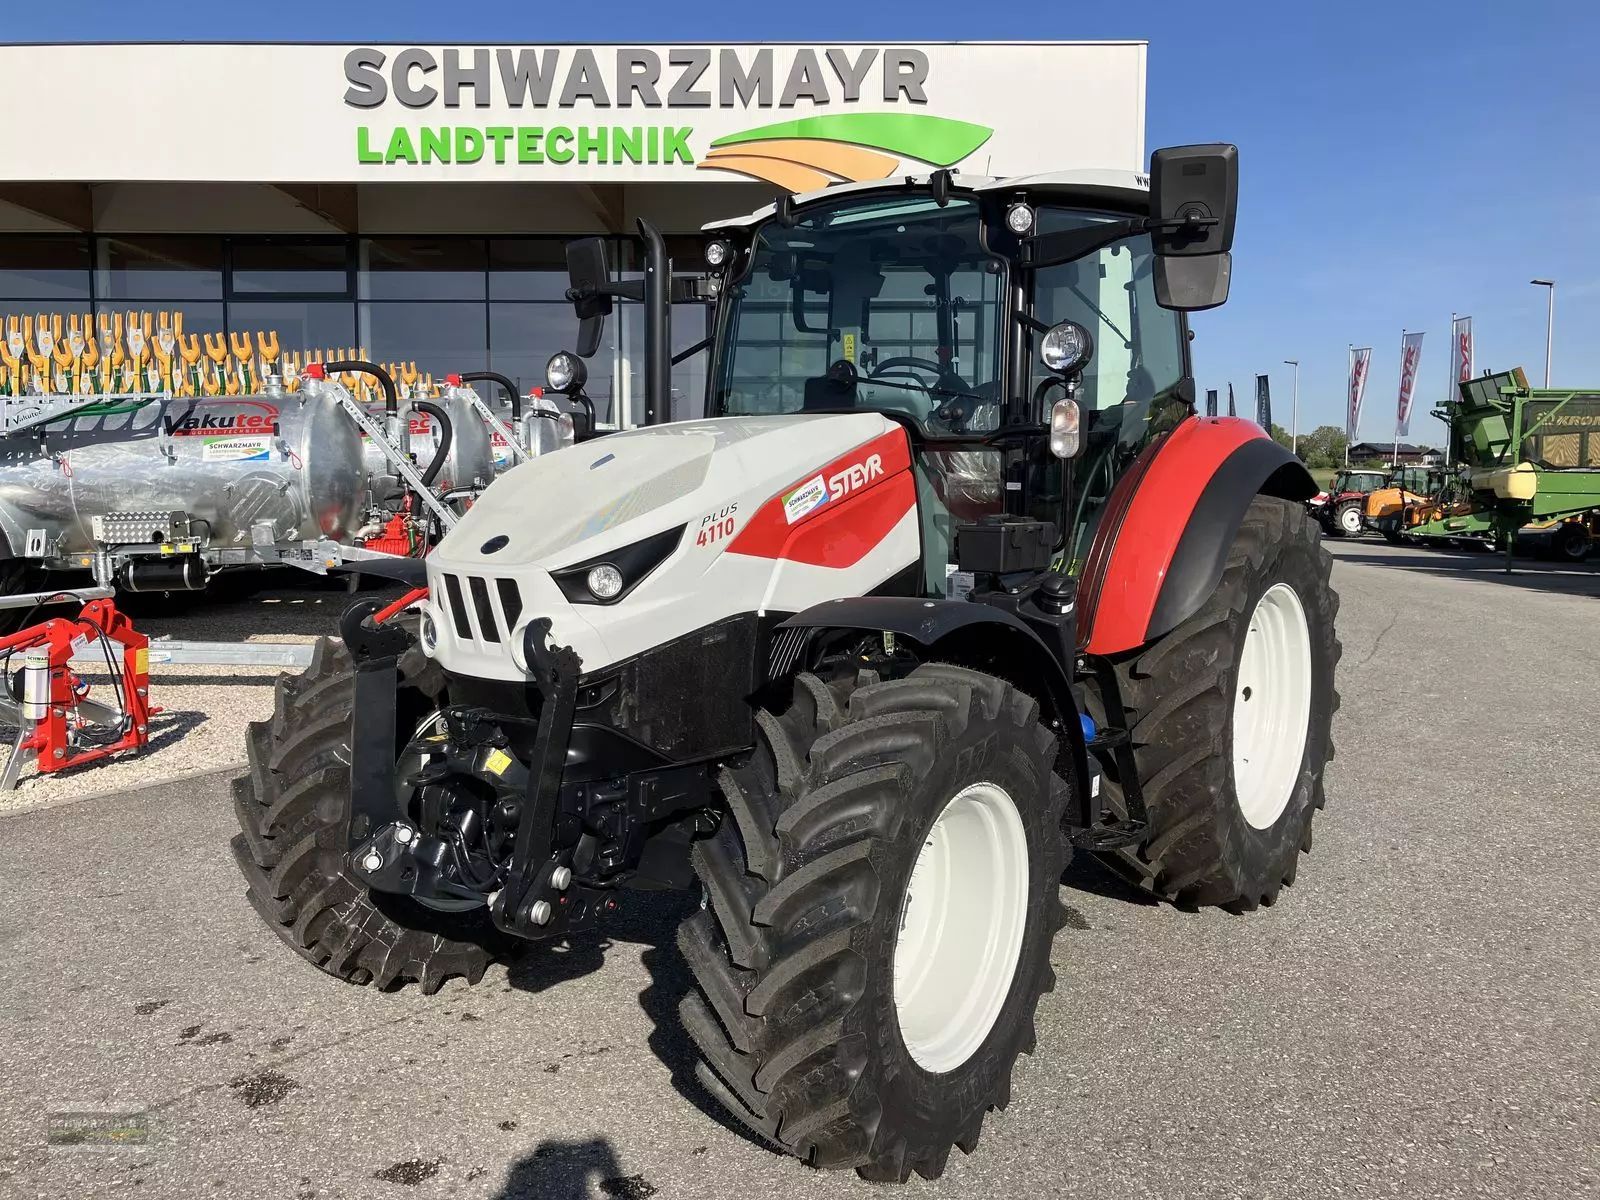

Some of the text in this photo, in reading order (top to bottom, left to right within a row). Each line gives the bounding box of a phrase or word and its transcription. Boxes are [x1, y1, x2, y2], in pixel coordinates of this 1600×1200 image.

[343, 48, 930, 108] SCHWARZMAYR
[357, 126, 695, 165] LANDTECHNIK
[164, 409, 278, 436] Vakutec
[209, 442, 261, 450] SCHWARZMAYR
[829, 453, 884, 502] STEYR
[702, 502, 738, 527] PLUS
[696, 517, 734, 546] 4110
